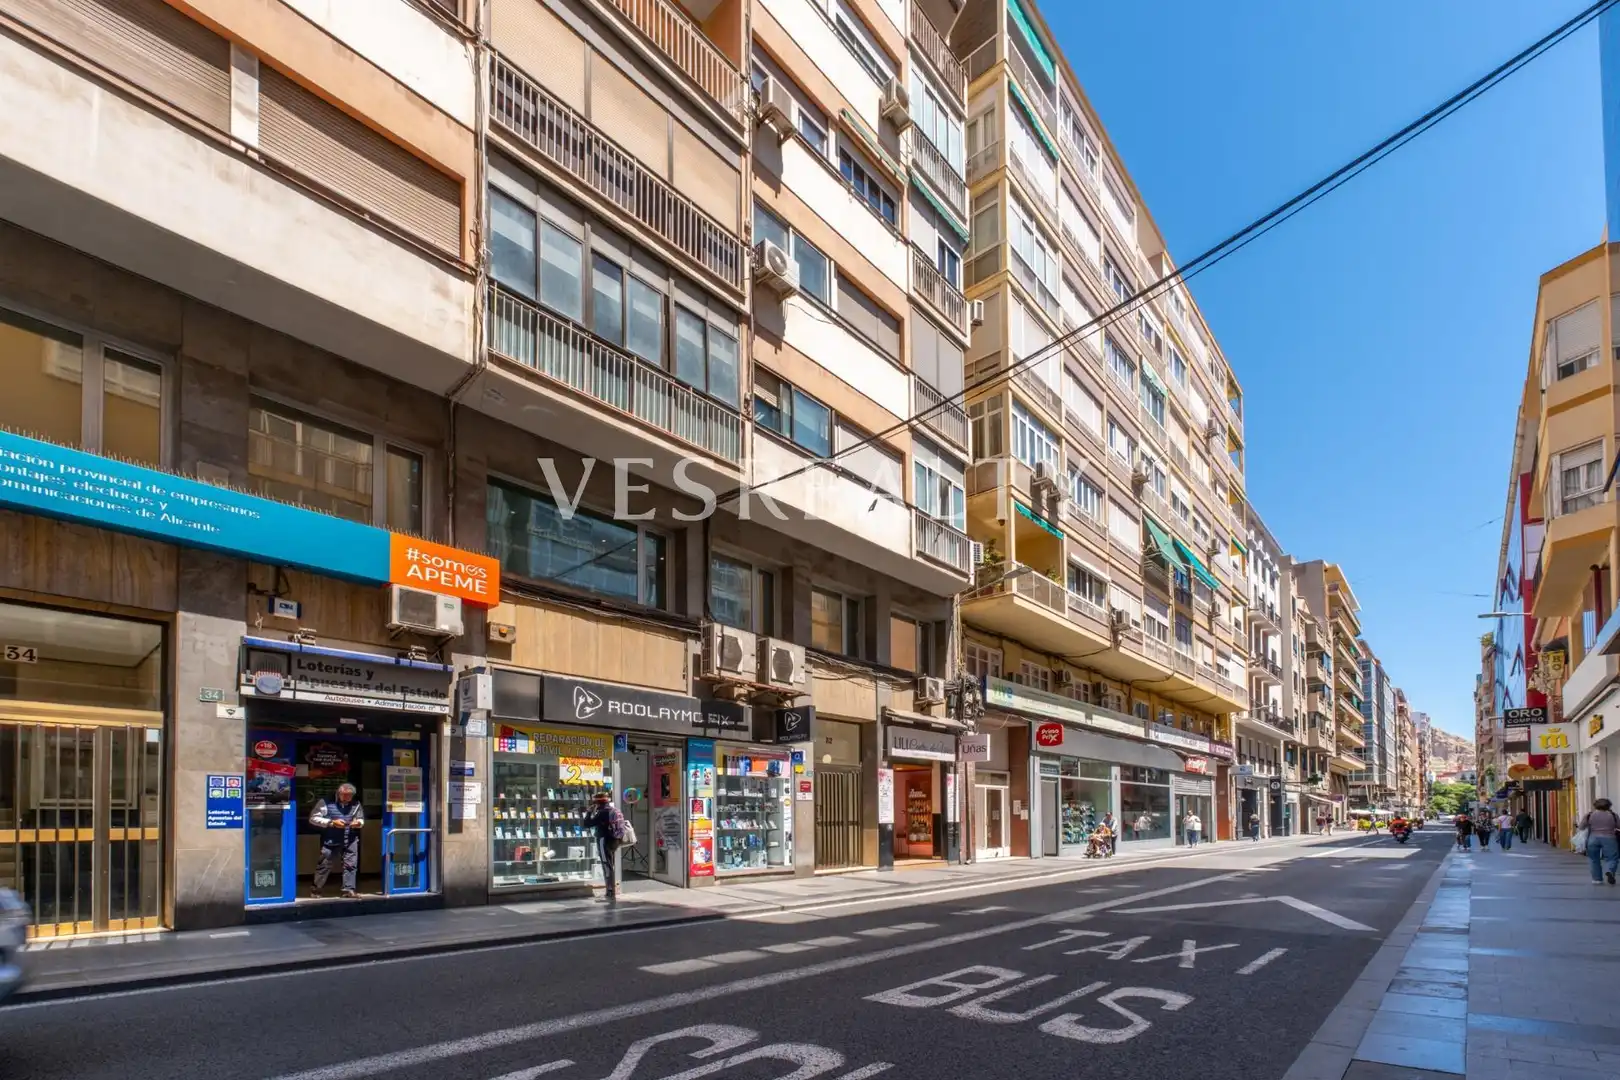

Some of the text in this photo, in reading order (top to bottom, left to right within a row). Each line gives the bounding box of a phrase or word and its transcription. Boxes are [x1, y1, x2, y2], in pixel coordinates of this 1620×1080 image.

[60, 464, 142, 491] provincial
[146, 484, 167, 497] de
[170, 491, 261, 520] empresarios
[160, 501, 168, 511] y
[135, 508, 156, 519] de
[161, 512, 221, 534] Alicante
[406, 564, 488, 595] APEME
[6, 646, 37, 662] 34
[365, 669, 374, 681] y
[296, 674, 372, 692] Apuestas
[373, 682, 397, 695] del
[400, 685, 447, 700] Estado
[204, 690, 220, 700] 34
[324, 694, 365, 705] Autobuses
[608, 701, 704, 723] ROOLAYMO
[1508, 708, 1543, 719] ORO
[1507, 716, 1544, 724] COMPRO
[595, 738, 606, 749] DE
[962, 744, 987, 754] Uñas
[575, 747, 608, 758] TABLET
[1022, 928, 1289, 975] TAXI
[862, 964, 1196, 1045] BUS
